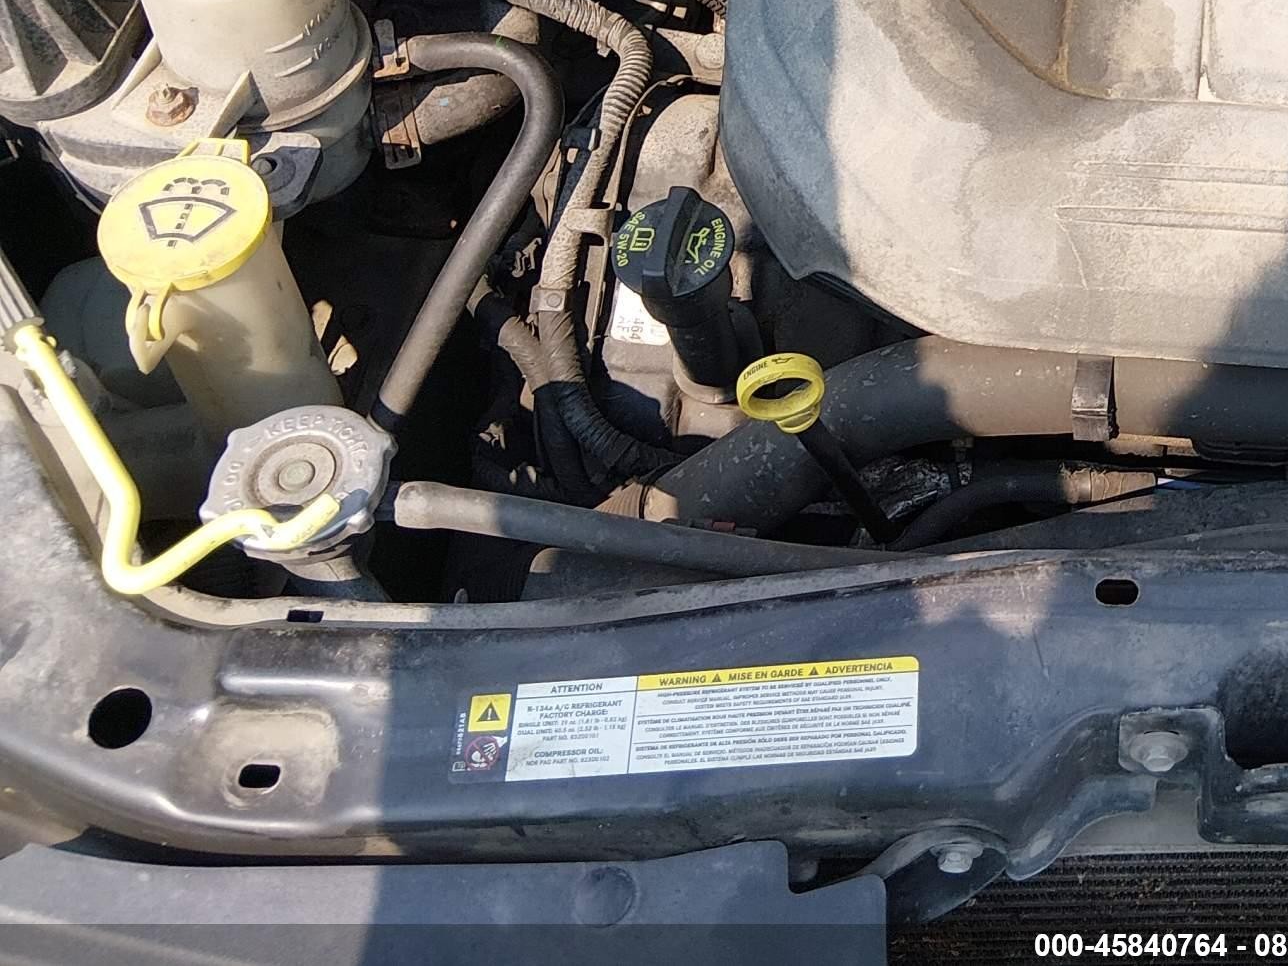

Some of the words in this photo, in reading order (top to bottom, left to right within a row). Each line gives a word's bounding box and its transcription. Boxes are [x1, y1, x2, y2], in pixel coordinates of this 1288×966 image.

[624, 210, 646, 233] SAE
[711, 217, 726, 259] ENGINE
[615, 233, 632, 268] 5W-20
[693, 259, 716, 277] OIL
[743, 360, 769, 381] ENGINE
[265, 414, 325, 438] KEEP
[658, 674, 706, 686] WARNING
[727, 671, 753, 682] MISE
[754, 670, 767, 680] EN
[769, 668, 803, 679] GARDE
[824, 661, 893, 675] ADVERTENCIA
[549, 682, 603, 694] ATTENTION
[538, 710, 573, 720] FACTORY
[570, 699, 623, 710] REFRIGERANT
